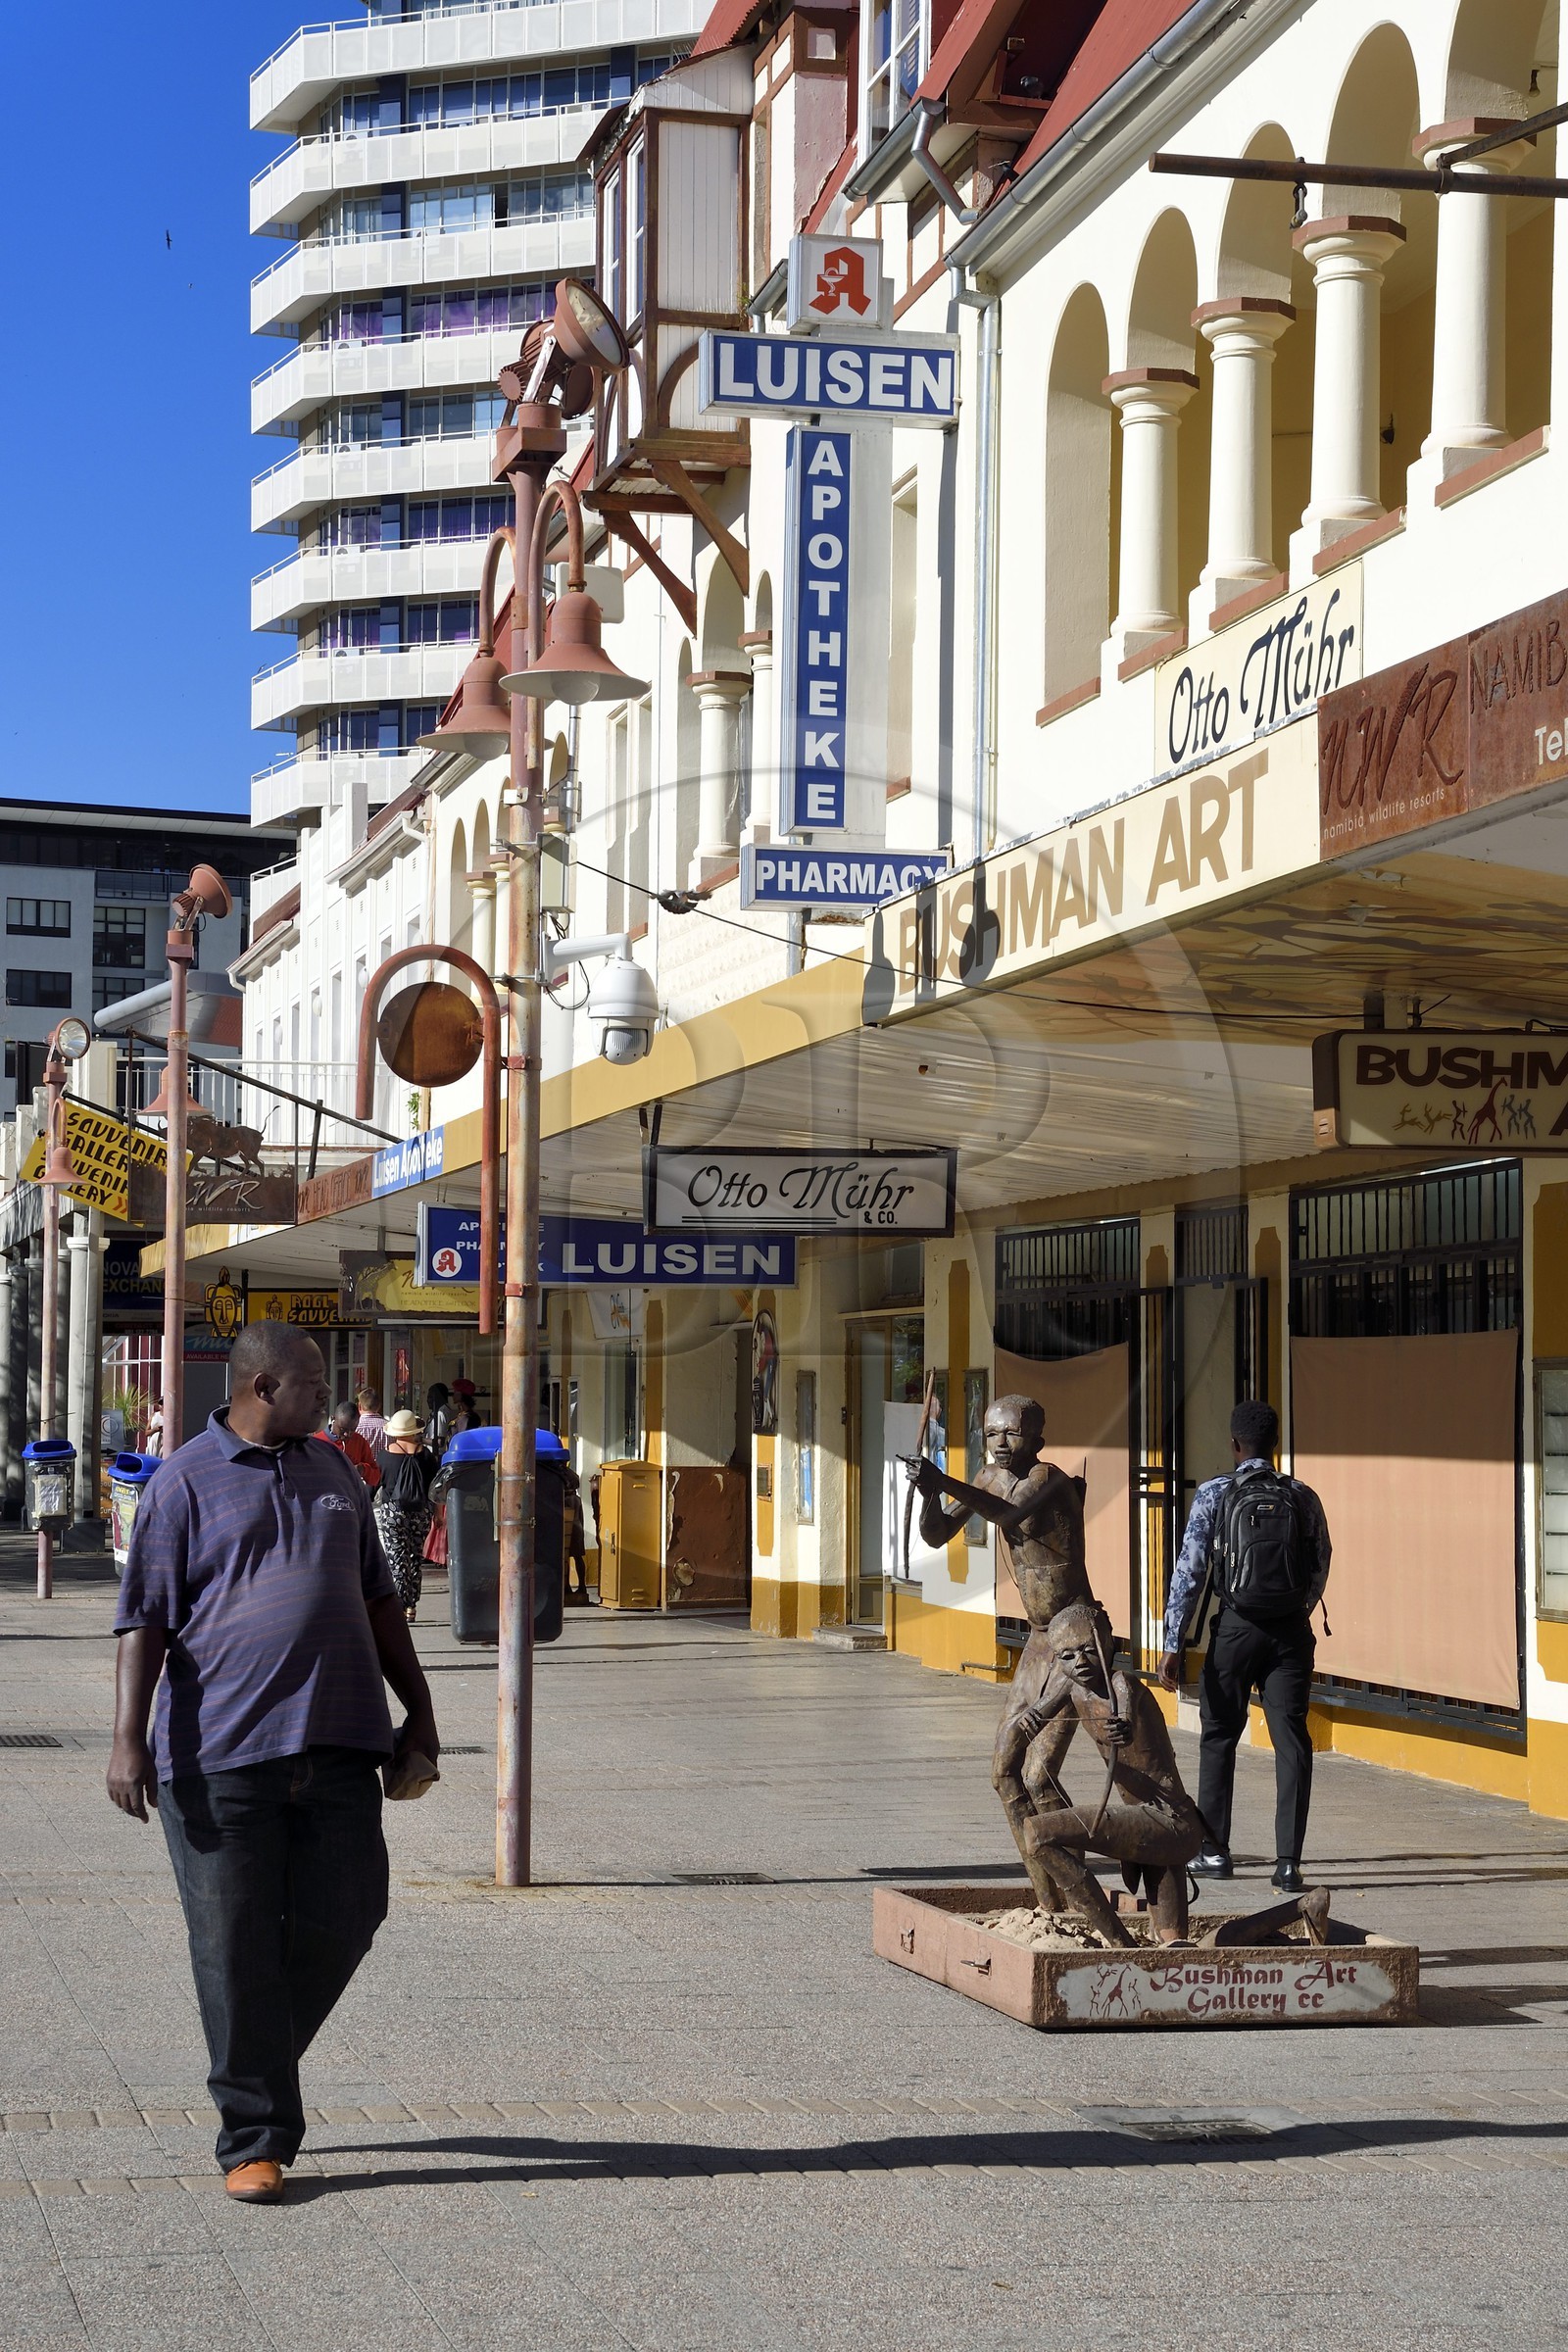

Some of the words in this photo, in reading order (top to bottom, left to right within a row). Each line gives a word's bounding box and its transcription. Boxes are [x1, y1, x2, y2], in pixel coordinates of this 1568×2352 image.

[719, 343, 952, 410] LUISEN
[804, 441, 843, 820] APOTHEKE
[1168, 666, 1229, 763] Otto
[1240, 588, 1354, 728] Mühr
[1323, 662, 1464, 815] NWR
[1323, 815, 1364, 840] namibia
[1369, 802, 1405, 823] wildlife
[1409, 787, 1446, 809] resorts
[899, 817, 1125, 996] BUSHMAN
[1145, 748, 1269, 906] ART
[374, 1152, 400, 1189] Luisen
[688, 1164, 767, 1207] Otto
[779, 1161, 914, 1218] Mühr
[863, 1210, 872, 1224] &
[878, 1211, 898, 1225] CO.
[562, 1243, 780, 1276] LUISEN
[329, 1496, 351, 1509] Ford
[1150, 1963, 1283, 1993] Bushman
[1294, 1960, 1357, 1990] Art
[1187, 1986, 1287, 2013] Gallery
